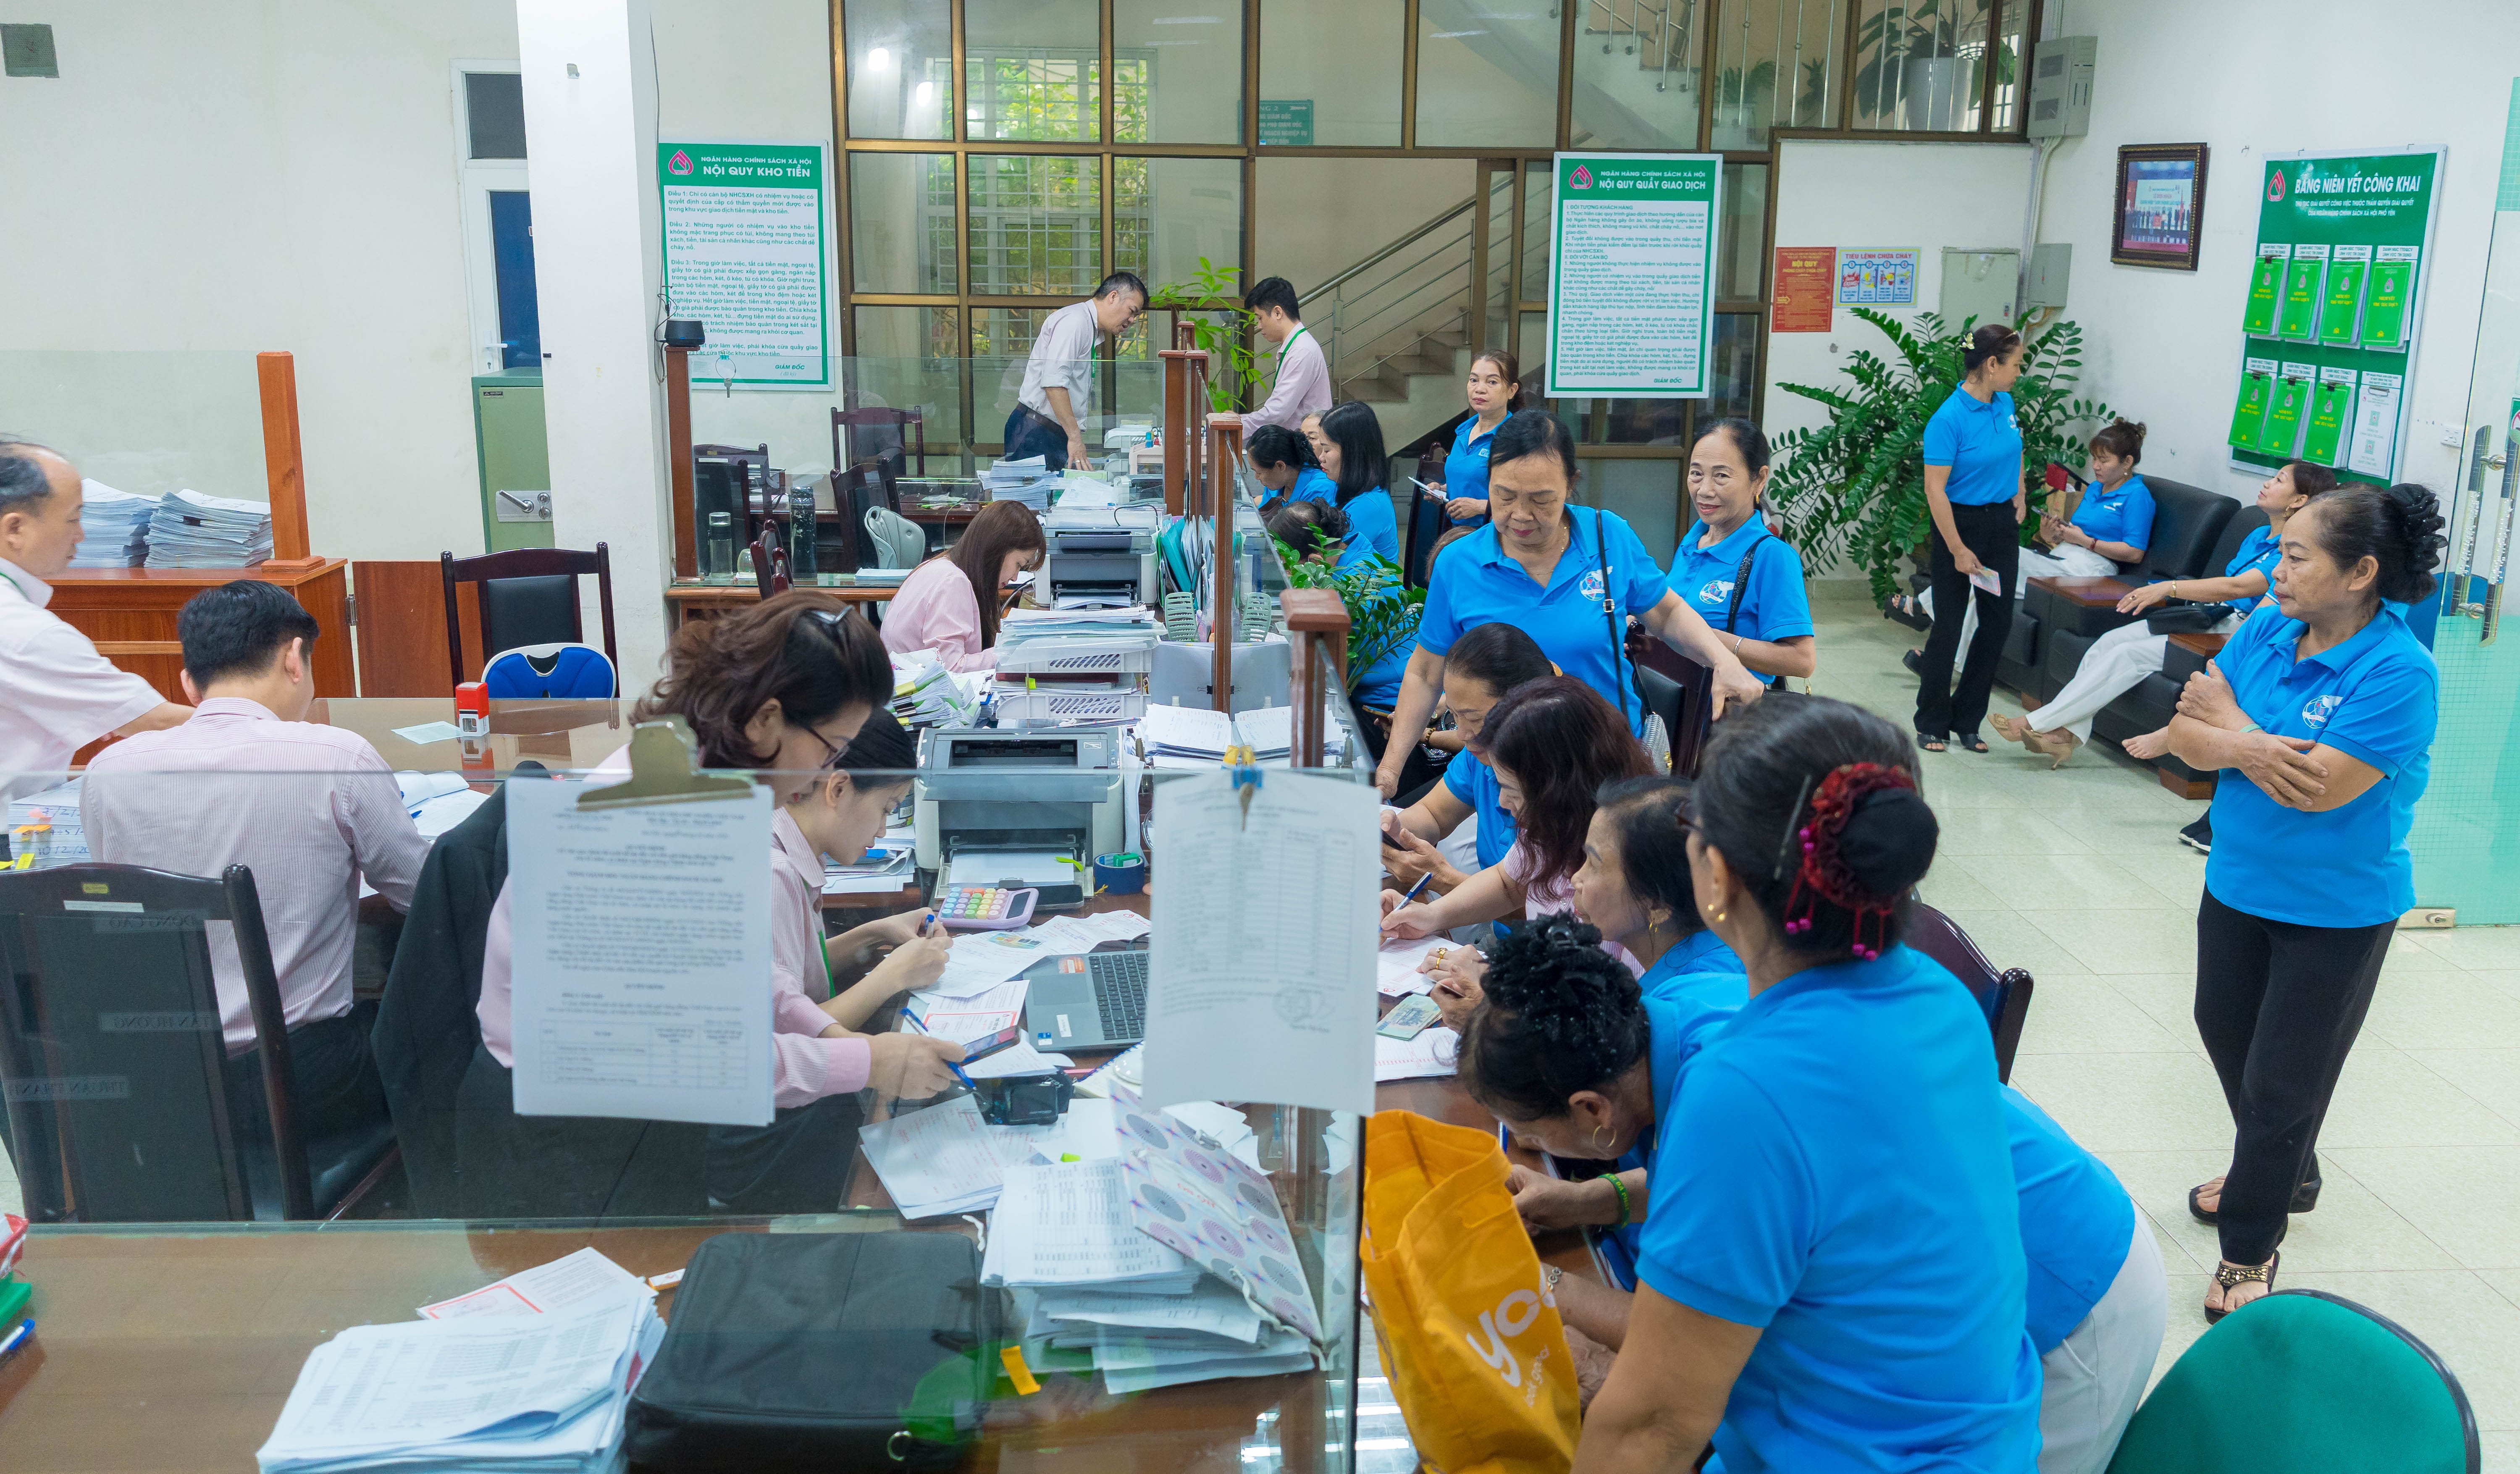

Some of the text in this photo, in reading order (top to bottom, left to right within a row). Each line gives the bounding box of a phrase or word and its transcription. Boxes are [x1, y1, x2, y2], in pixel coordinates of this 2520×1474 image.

[703, 164, 810, 177] NỘI QUY KHO TIỀN
[1599, 178, 1614, 191] NỘI
[1685, 181, 1705, 191] DỊCH
[2322, 174, 2345, 193] NIÊM
[2347, 171, 2362, 192] YẾT
[2364, 172, 2394, 192] CÔNG
[2396, 176, 2420, 191] KHAI
